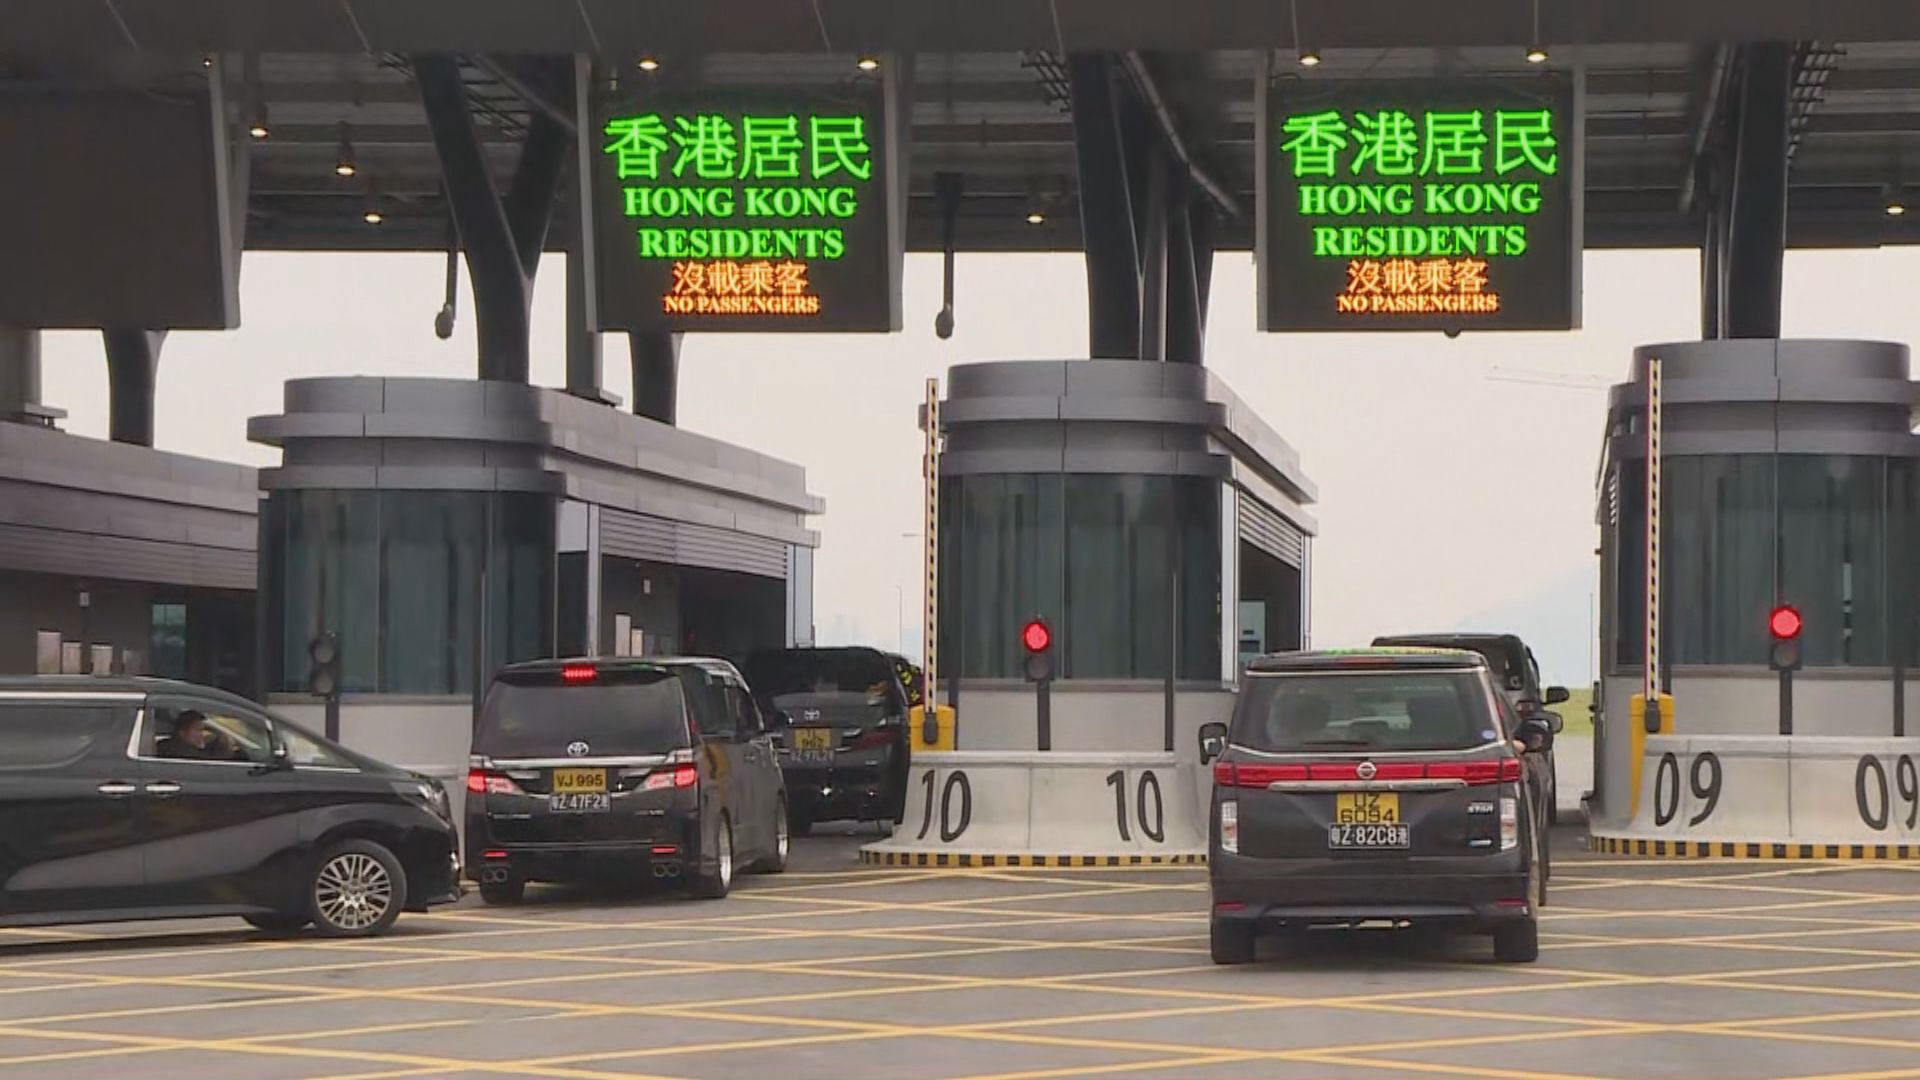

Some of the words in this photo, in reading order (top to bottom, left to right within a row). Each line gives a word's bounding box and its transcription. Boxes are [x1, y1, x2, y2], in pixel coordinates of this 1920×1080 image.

[605, 115, 870, 179] 香港居民
[1282, 110, 1557, 177] 香港居民
[624, 187, 735, 217] HONG
[744, 187, 857, 217] KONG
[1299, 184, 1413, 215] HONG
[1424, 184, 1540, 215] KONG
[639, 229, 844, 258] RESIDENTS
[1314, 226, 1526, 256] RESIDENTS
[672, 260, 809, 296] 沒載乘客
[1346, 258, 1488, 294] 沒載乘客
[664, 296, 694, 313] NO
[698, 296, 819, 313] PASSENGERS
[1337, 295, 1368, 312] NO
[1371, 295, 1498, 312] PASSENGERS
[556, 773, 573, 787] VJ
[575, 773, 604, 787] 995
[1654, 751, 1722, 827] 09
[1855, 754, 1919, 831] 09
[917, 769, 972, 842] 10
[1106, 769, 1165, 843] 10
[1340, 808, 1395, 824] 6094
